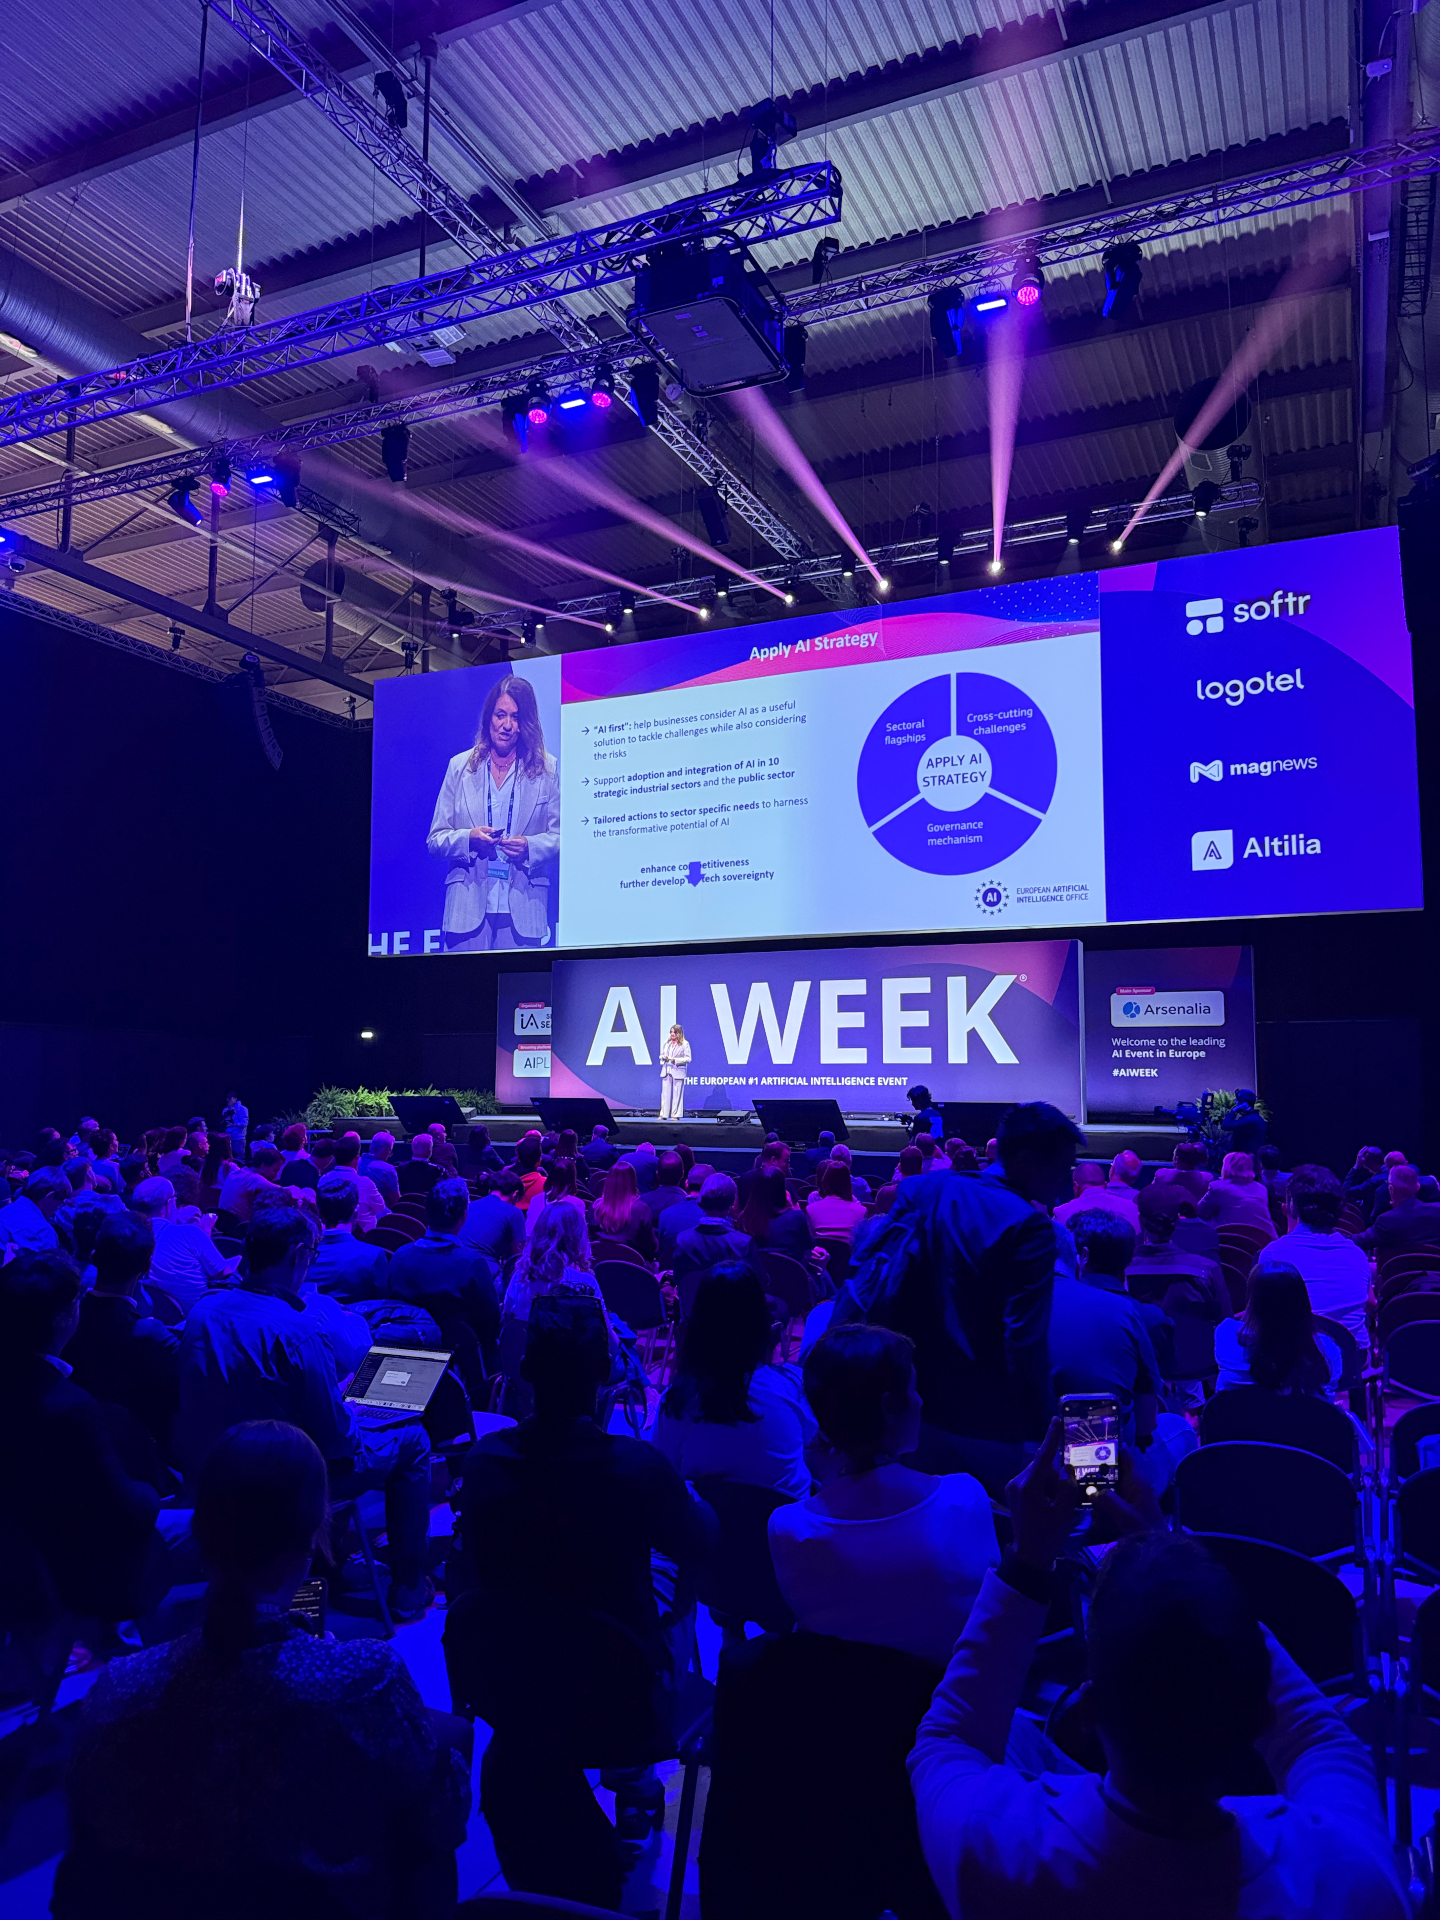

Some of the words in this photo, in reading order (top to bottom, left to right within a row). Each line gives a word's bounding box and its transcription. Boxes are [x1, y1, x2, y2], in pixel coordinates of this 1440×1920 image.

[1234, 590, 1310, 623] softr
[750, 642, 791, 662] Apply
[795, 639, 810, 653] AI
[814, 632, 878, 650] Strategy
[1197, 668, 1304, 706] logotel
[634, 719, 651, 730] help
[654, 714, 698, 728] businesses
[700, 708, 736, 722] consider
[739, 707, 747, 716] AI
[750, 706, 759, 714] as
[762, 705, 766, 713] a
[769, 700, 795, 712] useful
[967, 707, 1033, 723] Cross-cutting
[594, 736, 625, 747] solution
[628, 735, 636, 743] to
[638, 732, 662, 742] tackle
[665, 726, 708, 739] challenges
[711, 722, 733, 734] while
[736, 720, 753, 730] also
[756, 713, 806, 729] considering
[886, 719, 925, 732] Sectoral
[974, 721, 1026, 736] challenges
[885, 732, 926, 745] flagships
[594, 751, 607, 760] the
[609, 749, 627, 759] risks
[926, 754, 965, 769] APPLY
[970, 753, 982, 764] AI
[594, 775, 625, 786] Support
[628, 770, 664, 783] adoption
[667, 768, 682, 777] and
[685, 762, 732, 776] integration
[734, 761, 744, 770] of
[746, 760, 755, 768] AI
[758, 759, 765, 767] in
[769, 757, 779, 766] 10
[1230, 756, 1318, 776] magnews
[594, 787, 628, 798] strategic
[630, 783, 669, 794] industrial
[671, 779, 701, 790] sectors
[703, 777, 719, 787] and
[721, 776, 736, 785] the
[738, 772, 764, 785] public
[767, 770, 795, 780] sector
[922, 771, 987, 787] STRATEGY
[594, 814, 626, 825] Tailored
[628, 811, 657, 822] actions
[660, 810, 668, 818] to
[670, 807, 696, 817] sector
[699, 804, 731, 816] specific
[733, 801, 759, 812] needs
[762, 800, 771, 808] to
[774, 796, 808, 808] harness
[594, 828, 606, 838] the
[608, 824, 668, 836] transformative
[670, 819, 708, 833] potential
[710, 818, 719, 827] of
[720, 818, 729, 826] AI
[927, 820, 983, 833] Governance
[928, 834, 983, 846] mechanism
[1243, 833, 1321, 858] Altilia
[641, 864, 676, 874] enhance
[678, 859, 749, 871] coetitiveness
[620, 878, 649, 889] further
[652, 876, 685, 887] develop
[702, 872, 720, 883] tech
[723, 870, 774, 882] sovereignty
[1053, 884, 1089, 893] ARTIFICIAL
[986, 892, 997, 902] AI
[1017, 895, 1064, 903] INTELLIGENCE
[1066, 893, 1088, 901] OFFICE
[1144, 1003, 1210, 1015] Arsenalia
[1112, 1038, 1155, 1046] Welcome
[1170, 1038, 1187, 1046] the
[1190, 1037, 1225, 1047] leading
[1112, 1050, 1122, 1058] AI
[1125, 1050, 1154, 1058] Event
[1169, 1050, 1206, 1059] Europe
[1112, 1069, 1158, 1077] #AIWEEK
[700, 1077, 746, 1085] EUROPEAN
[748, 1077, 758, 1085] #1
[761, 1077, 808, 1085] ARTIFICIAL
[811, 1077, 875, 1085] INTELLIGENCE
[878, 1077, 908, 1085] EVENT
